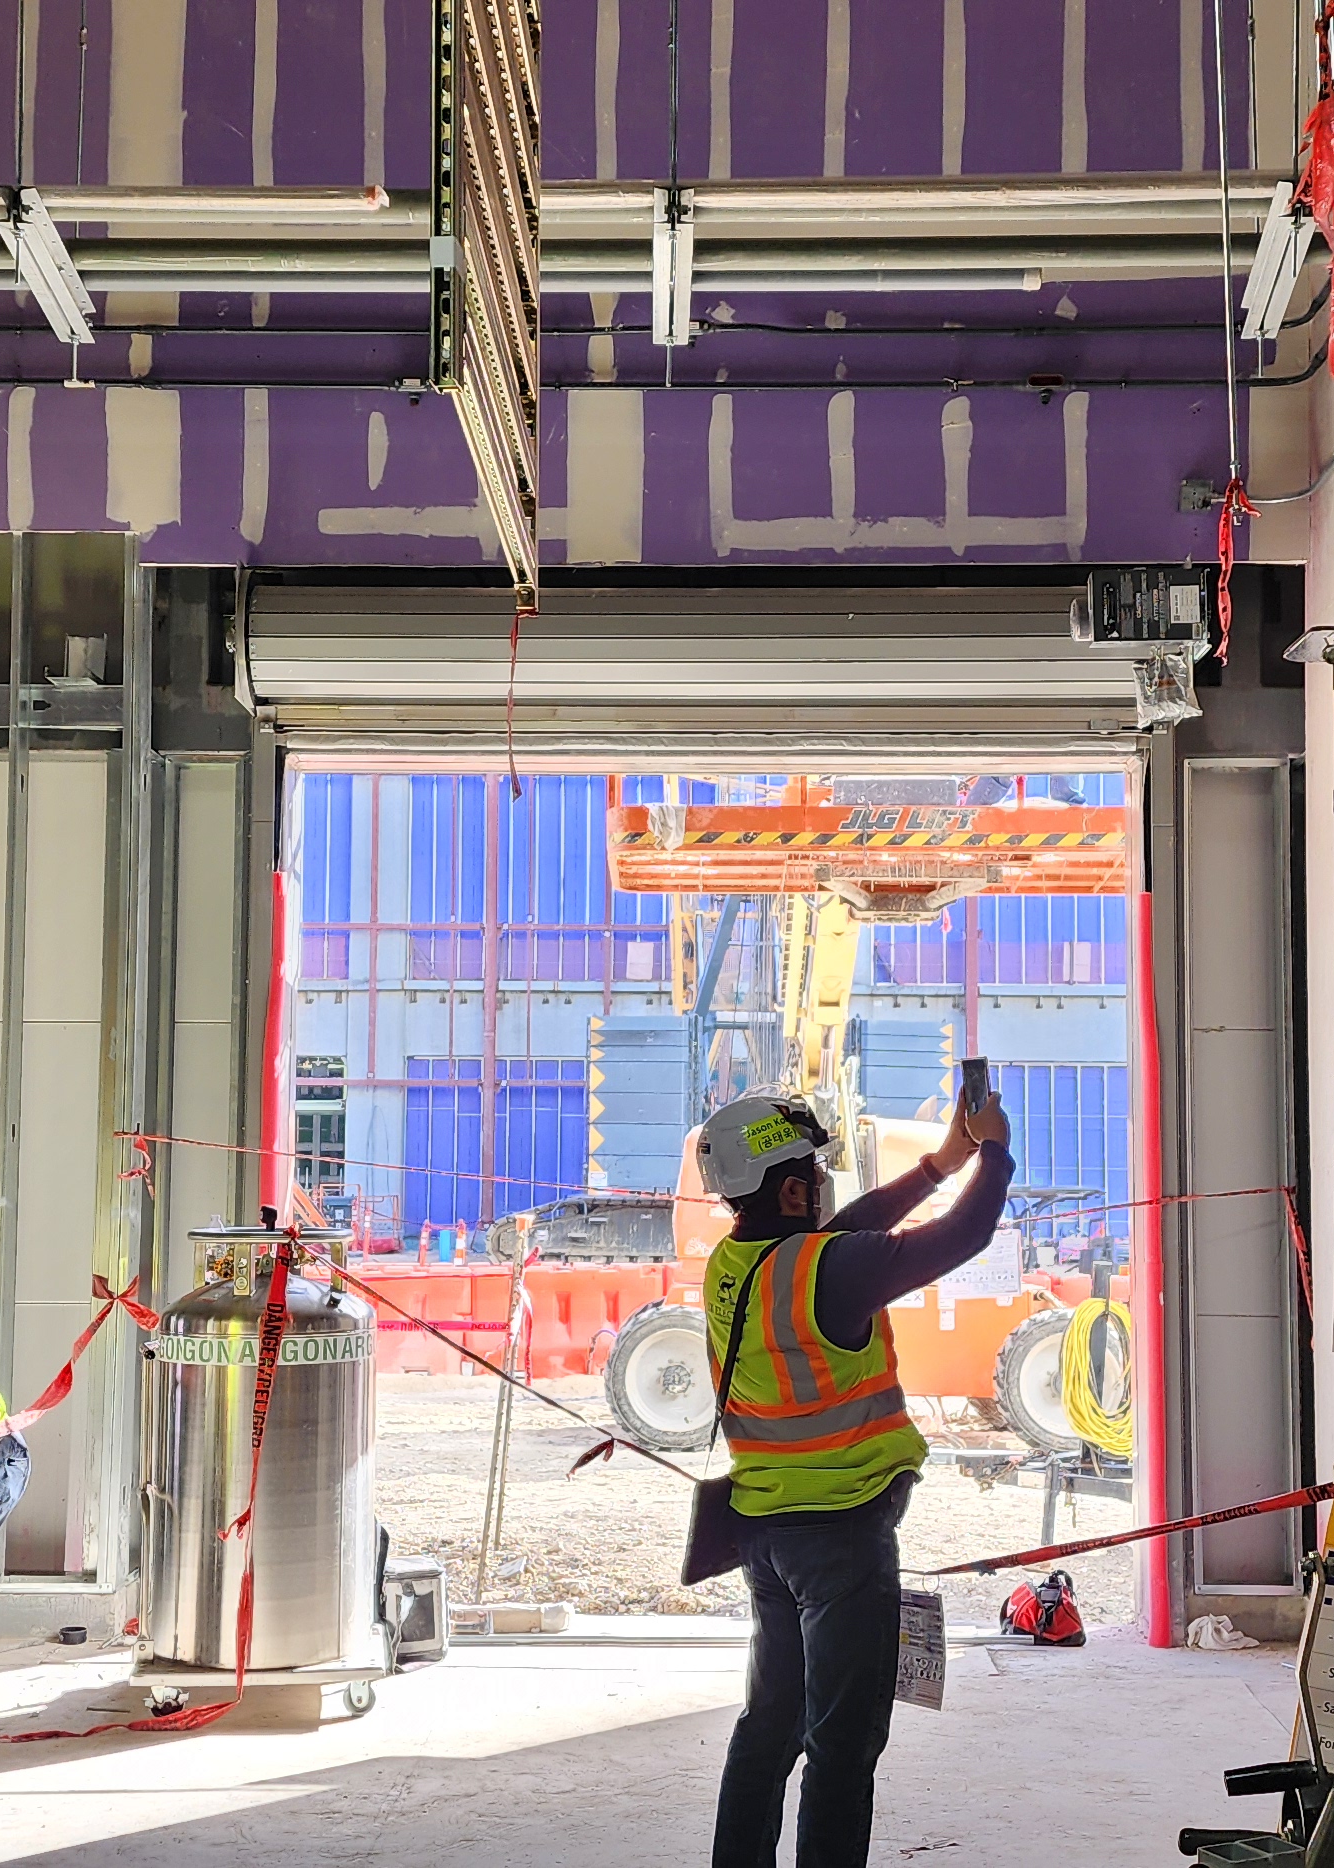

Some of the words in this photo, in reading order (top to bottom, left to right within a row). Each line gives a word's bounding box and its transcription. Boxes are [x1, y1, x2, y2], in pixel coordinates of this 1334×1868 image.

[838, 807, 903, 831] JLG
[904, 807, 978, 831] LIFT
[746, 1122, 774, 1139] Jason
